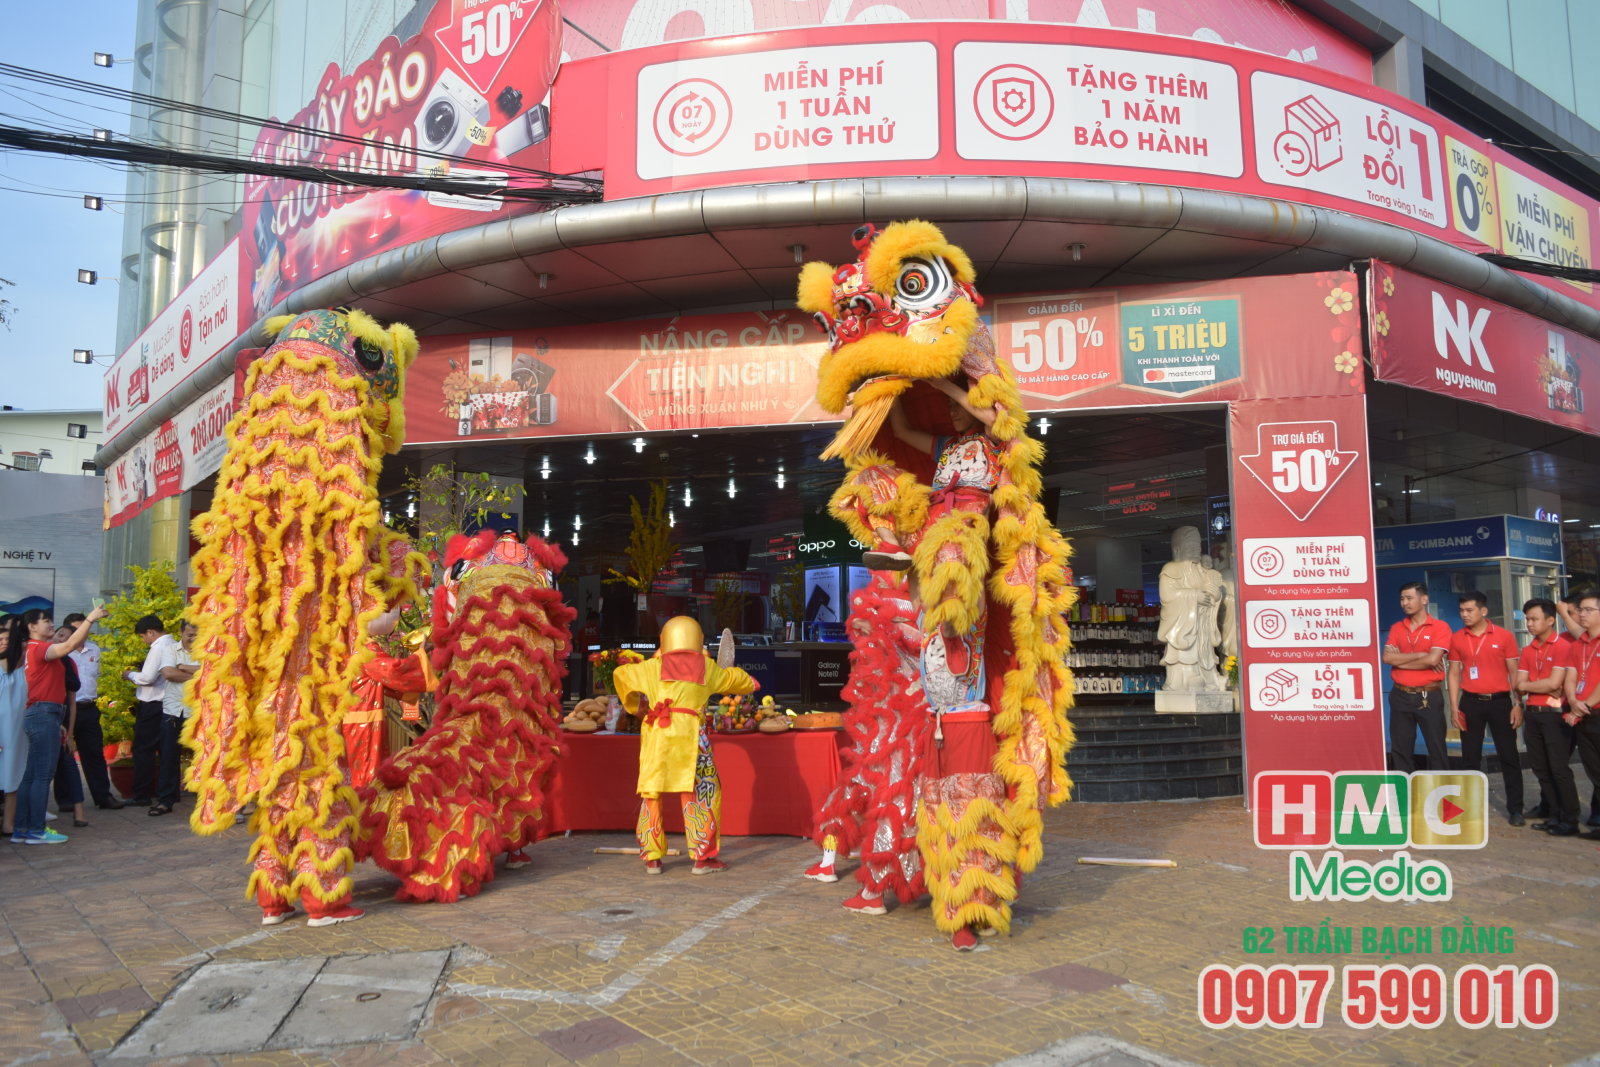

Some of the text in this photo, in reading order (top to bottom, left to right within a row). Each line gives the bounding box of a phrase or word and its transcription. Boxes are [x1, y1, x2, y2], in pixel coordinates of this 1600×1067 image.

[461, 4, 523, 65] 50%
[354, 50, 427, 122] ĐẢO
[764, 60, 885, 92] MIỄN PHÍ
[1066, 64, 1208, 100] TẶNG THÊM
[682, 105, 702, 120] 07
[777, 87, 871, 120] 1 TUẦN
[1102, 99, 1181, 126] 1 NĂM
[470, 126, 488, 144] -50%
[682, 120, 702, 128] NGÀY
[754, 117, 896, 152] DÙNG THỬ
[1074, 121, 1208, 157] BẢO HÀNH
[338, 127, 413, 197] NĂM
[1366, 109, 1434, 202] LỖI 1
[1452, 148, 1489, 179] TRẢ GÓP
[1362, 148, 1405, 190] ĐỔI
[1367, 190, 1435, 220] Trong vòng 1 năm
[1456, 173, 1493, 232] 0%
[1517, 193, 1575, 240] MIỄN PHÍ
[1505, 219, 1588, 269] VẬN CHUYỂN
[1028, 301, 1083, 315] GIẢM ĐẾN
[1151, 302, 1202, 317] LÌ XÌ ĐẾN
[198, 299, 228, 345] Tận nơi
[1432, 290, 1495, 373] NK
[640, 314, 806, 357] NÂNG CẤP
[1011, 316, 1104, 373] 50%
[1128, 318, 1227, 353] 5 TRIỆU
[152, 352, 174, 384] Dễ dàng
[1152, 357, 1179, 365] THANH
[1181, 354, 1203, 363] TOÁN
[1204, 354, 1220, 362] VỚI
[646, 360, 796, 397] TIỆN NGHI
[1029, 374, 1045, 384] MẶT
[1047, 373, 1070, 382] HÀNG
[1168, 369, 1212, 378] mastercard
[107, 366, 121, 418] NK
[658, 397, 779, 416] MỪNG XUÂN NHƯ Ý
[1272, 430, 1324, 446] TRỢ GIÁ ĐẾN
[1272, 448, 1340, 493] 50%
[1122, 502, 1157, 515] GIÁ SỐC
[799, 540, 836, 553] oppo
[1296, 542, 1345, 554] MIỄN PHÍ
[1408, 536, 1474, 550] EXIMBANK
[1526, 535, 1553, 547] EXIMBANK
[3, 550, 52, 562] NGHỆ TV
[1311, 554, 1340, 565] TUẦN
[1293, 565, 1350, 578] DÙNG THỬ
[1326, 586, 1348, 594] phẩm
[1291, 606, 1354, 620] TẶNG THÊM
[1306, 618, 1341, 628] 1 NĂM
[1294, 630, 1354, 640] BẢO HÀNH
[1282, 650, 1302, 659] dụng
[1330, 649, 1352, 658] phẩm
[818, 662, 840, 670] Galaxy
[1311, 682, 1340, 700] ĐỔI
[1314, 665, 1364, 700] LỖI 1
[1286, 714, 1305, 722] dụng
[1334, 713, 1356, 722] phẩm
